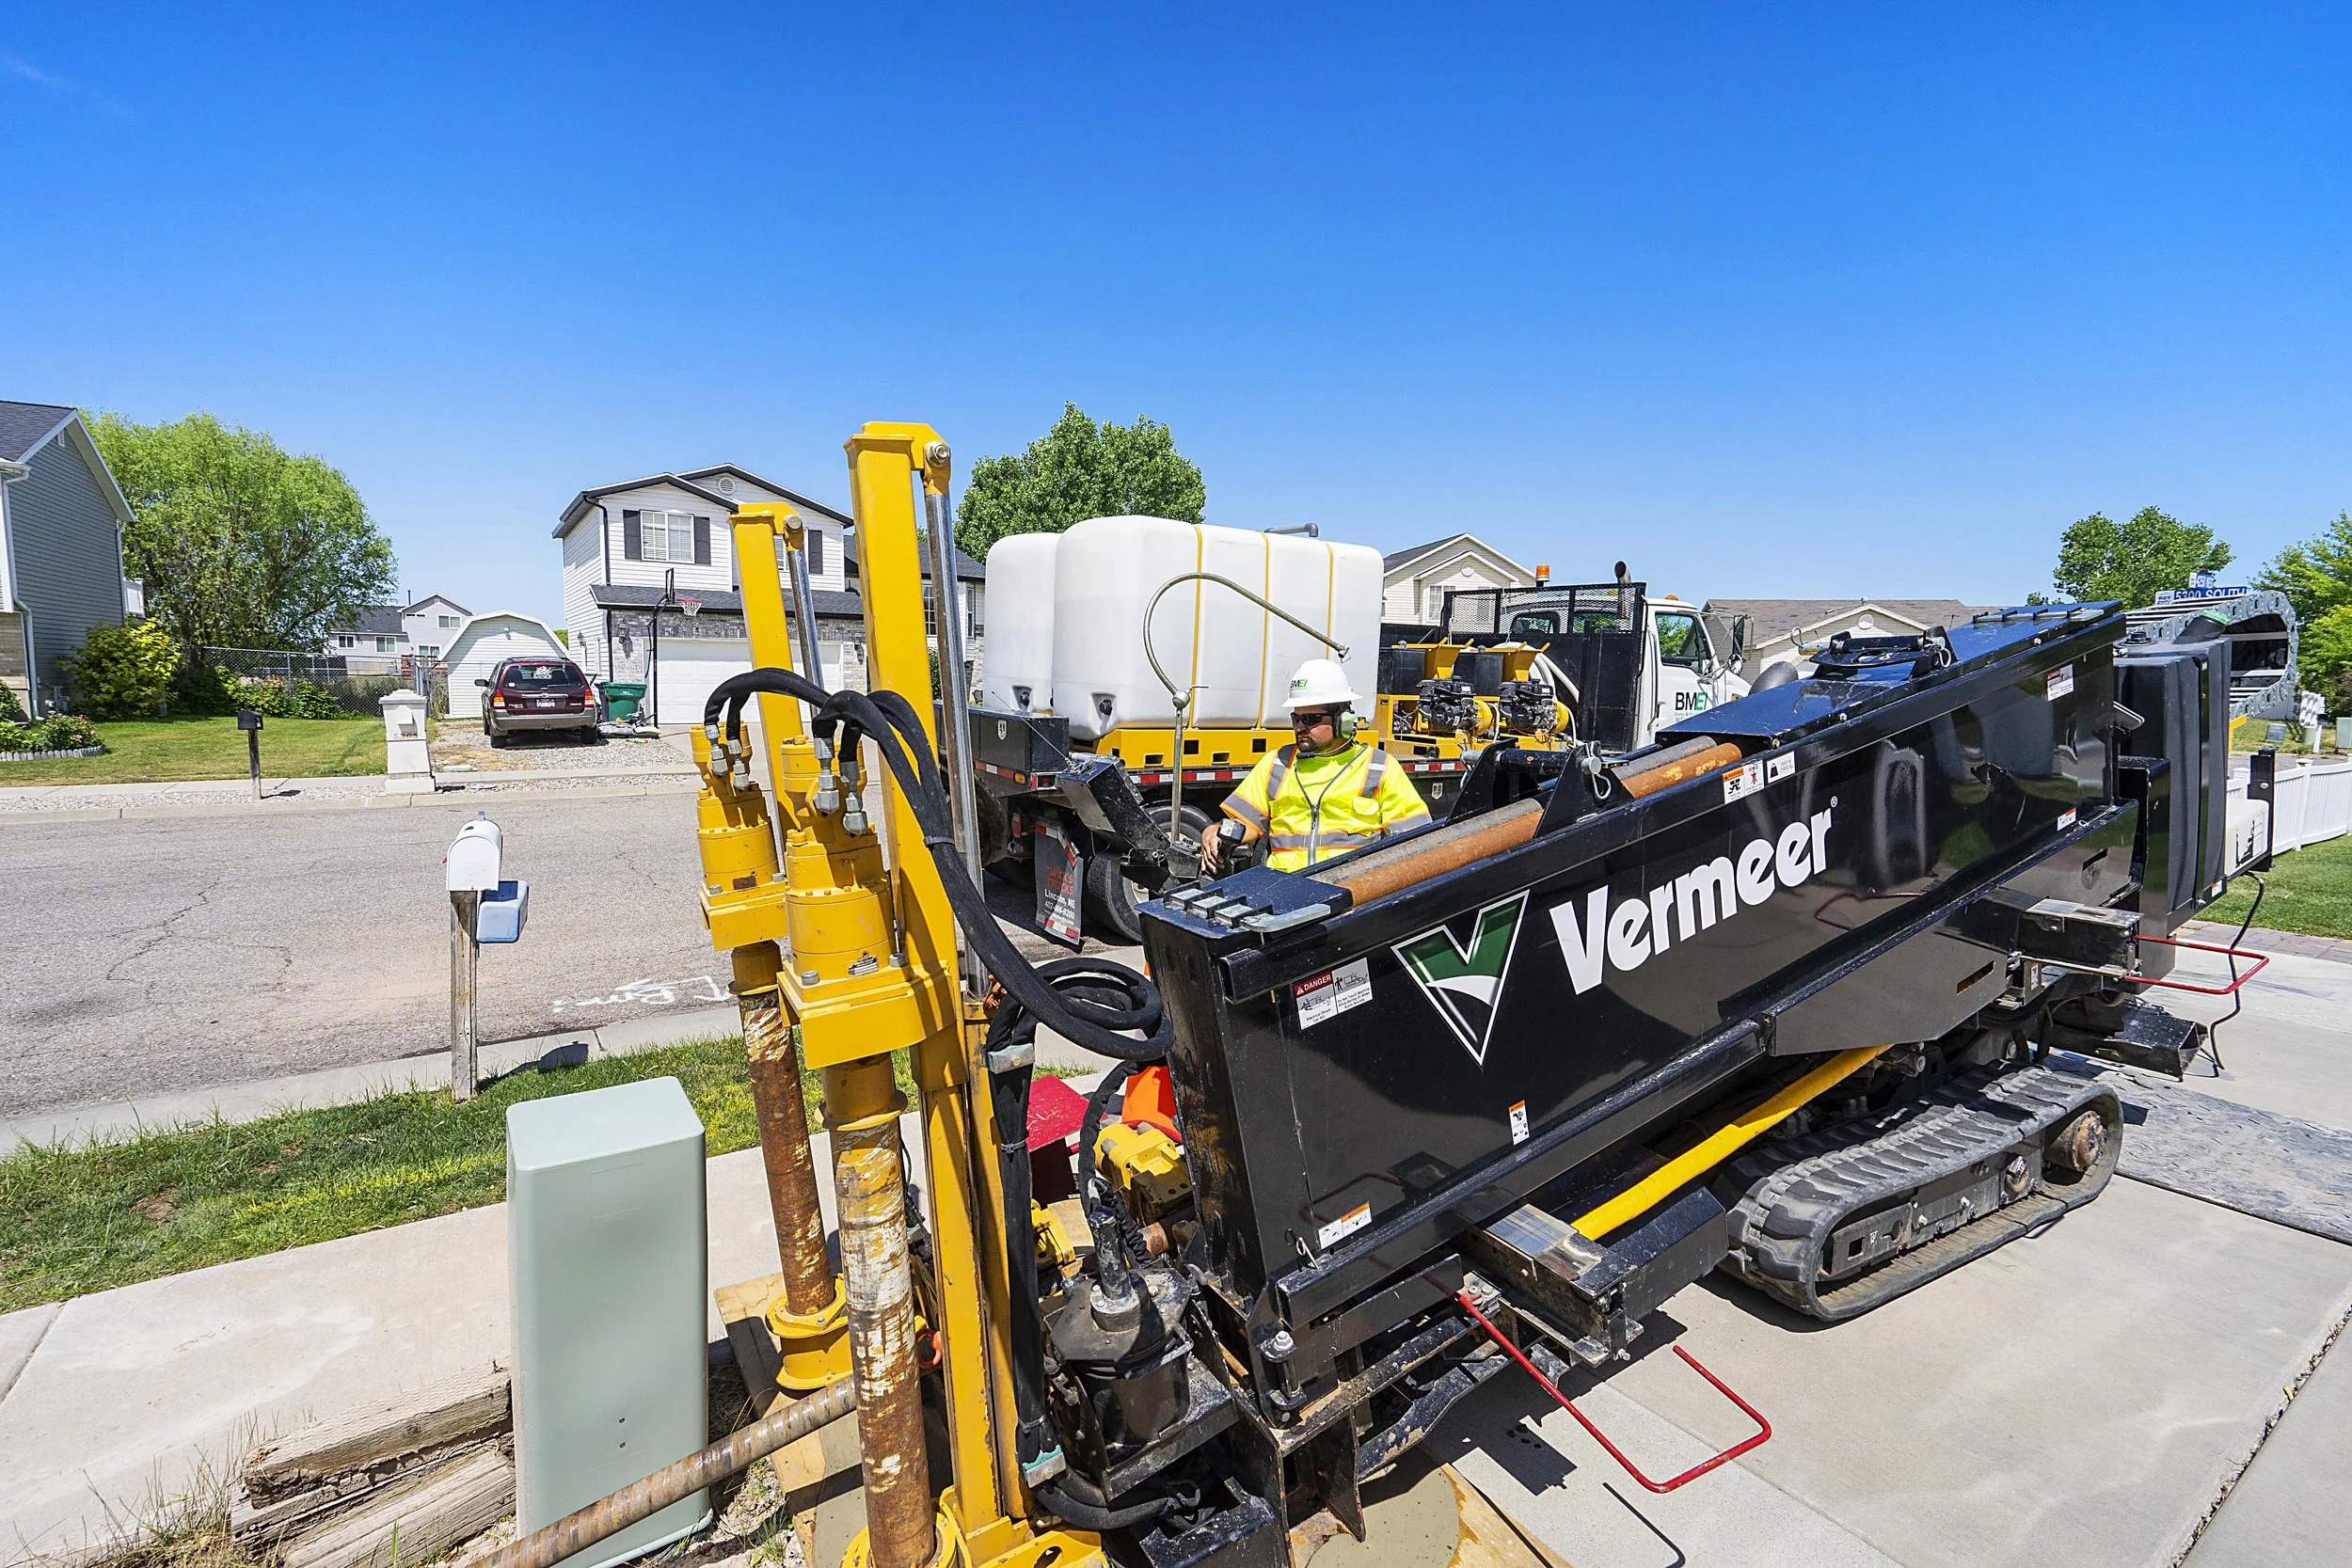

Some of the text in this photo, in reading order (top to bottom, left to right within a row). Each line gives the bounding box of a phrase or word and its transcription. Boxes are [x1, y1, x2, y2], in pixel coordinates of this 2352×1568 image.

[2176, 591, 2201, 600] 5300
[1675, 691, 1708, 711] BMEI
[1046, 877, 1074, 895] TRUCKS
[1068, 897, 1075, 909] NE
[1549, 808, 1832, 995] Vermeer
[1304, 974, 1331, 990] DANGER
